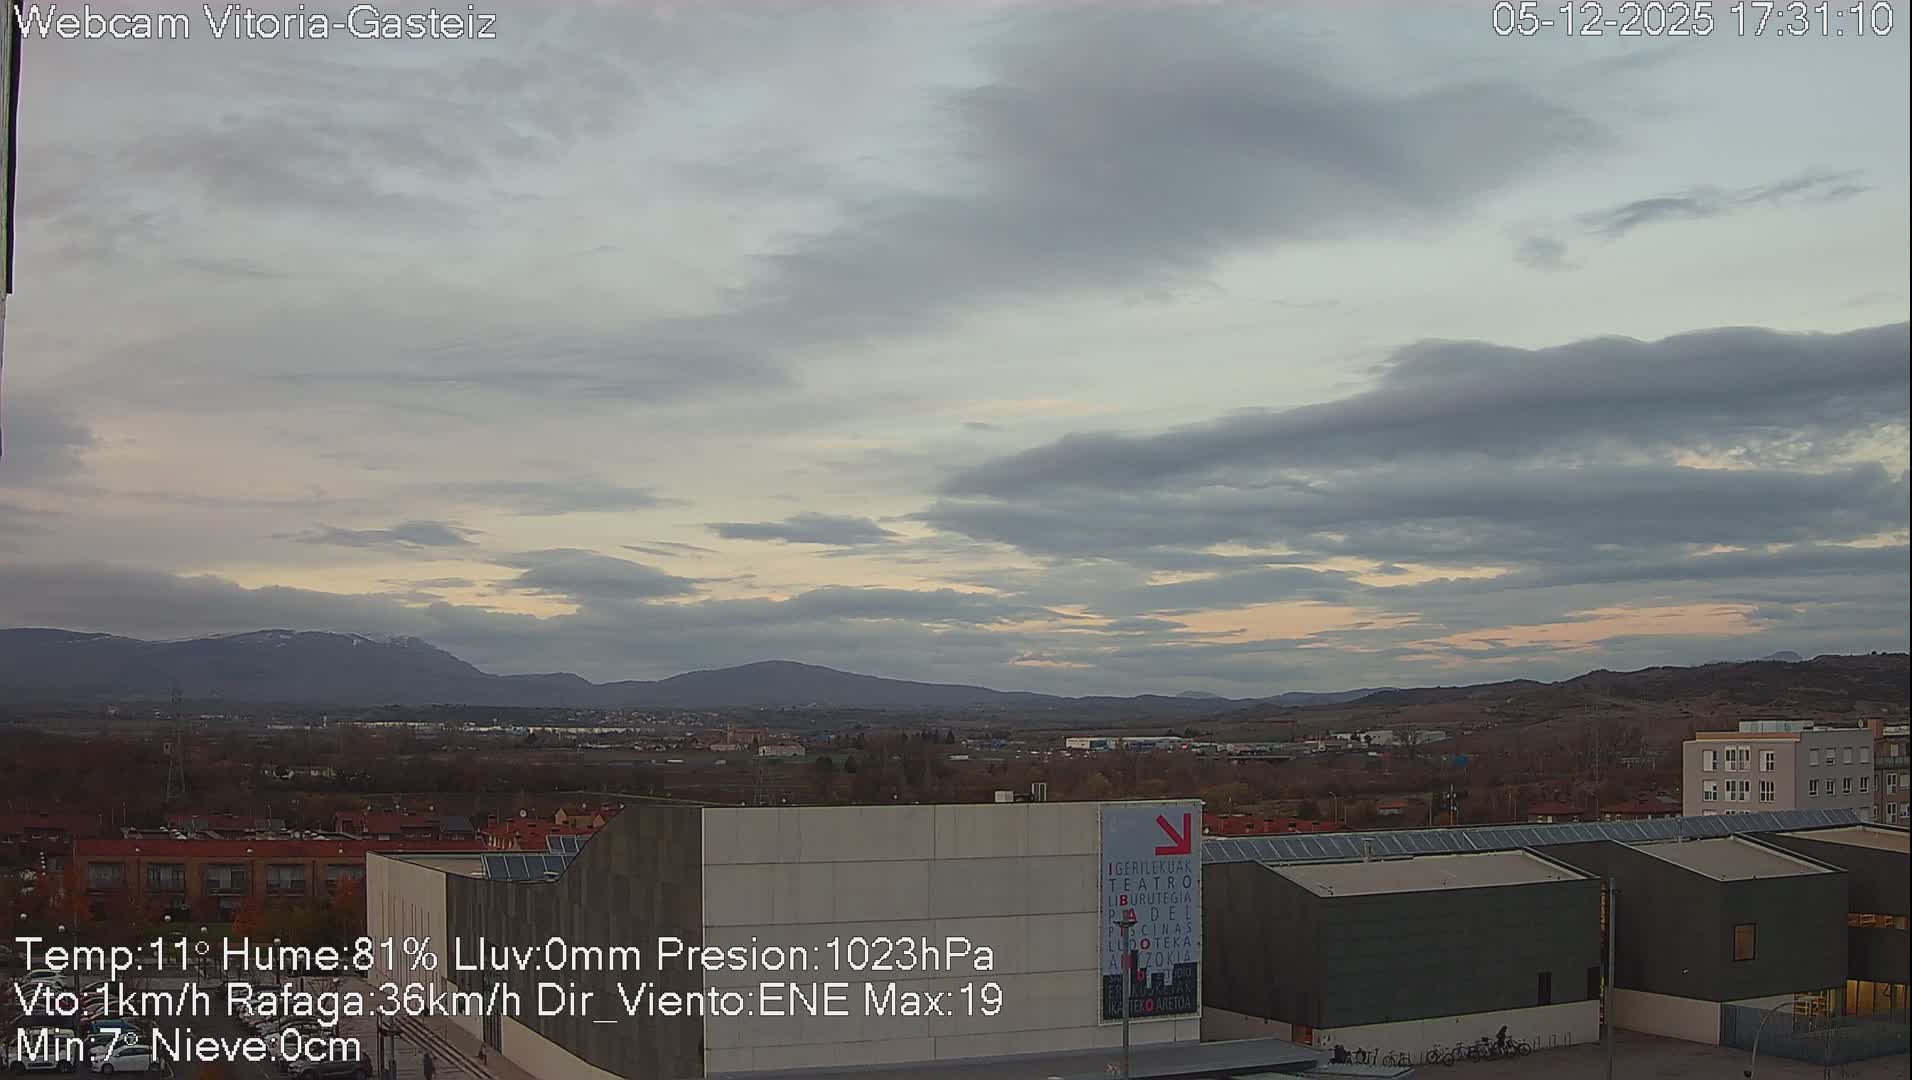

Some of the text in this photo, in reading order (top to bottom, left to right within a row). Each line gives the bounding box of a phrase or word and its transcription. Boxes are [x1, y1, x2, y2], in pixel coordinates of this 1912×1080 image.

[1108, 859, 1192, 876] IGERILEKUAK
[1108, 875, 1192, 892] TEATRO
[1108, 891, 1192, 907] LIBURUTEGIA
